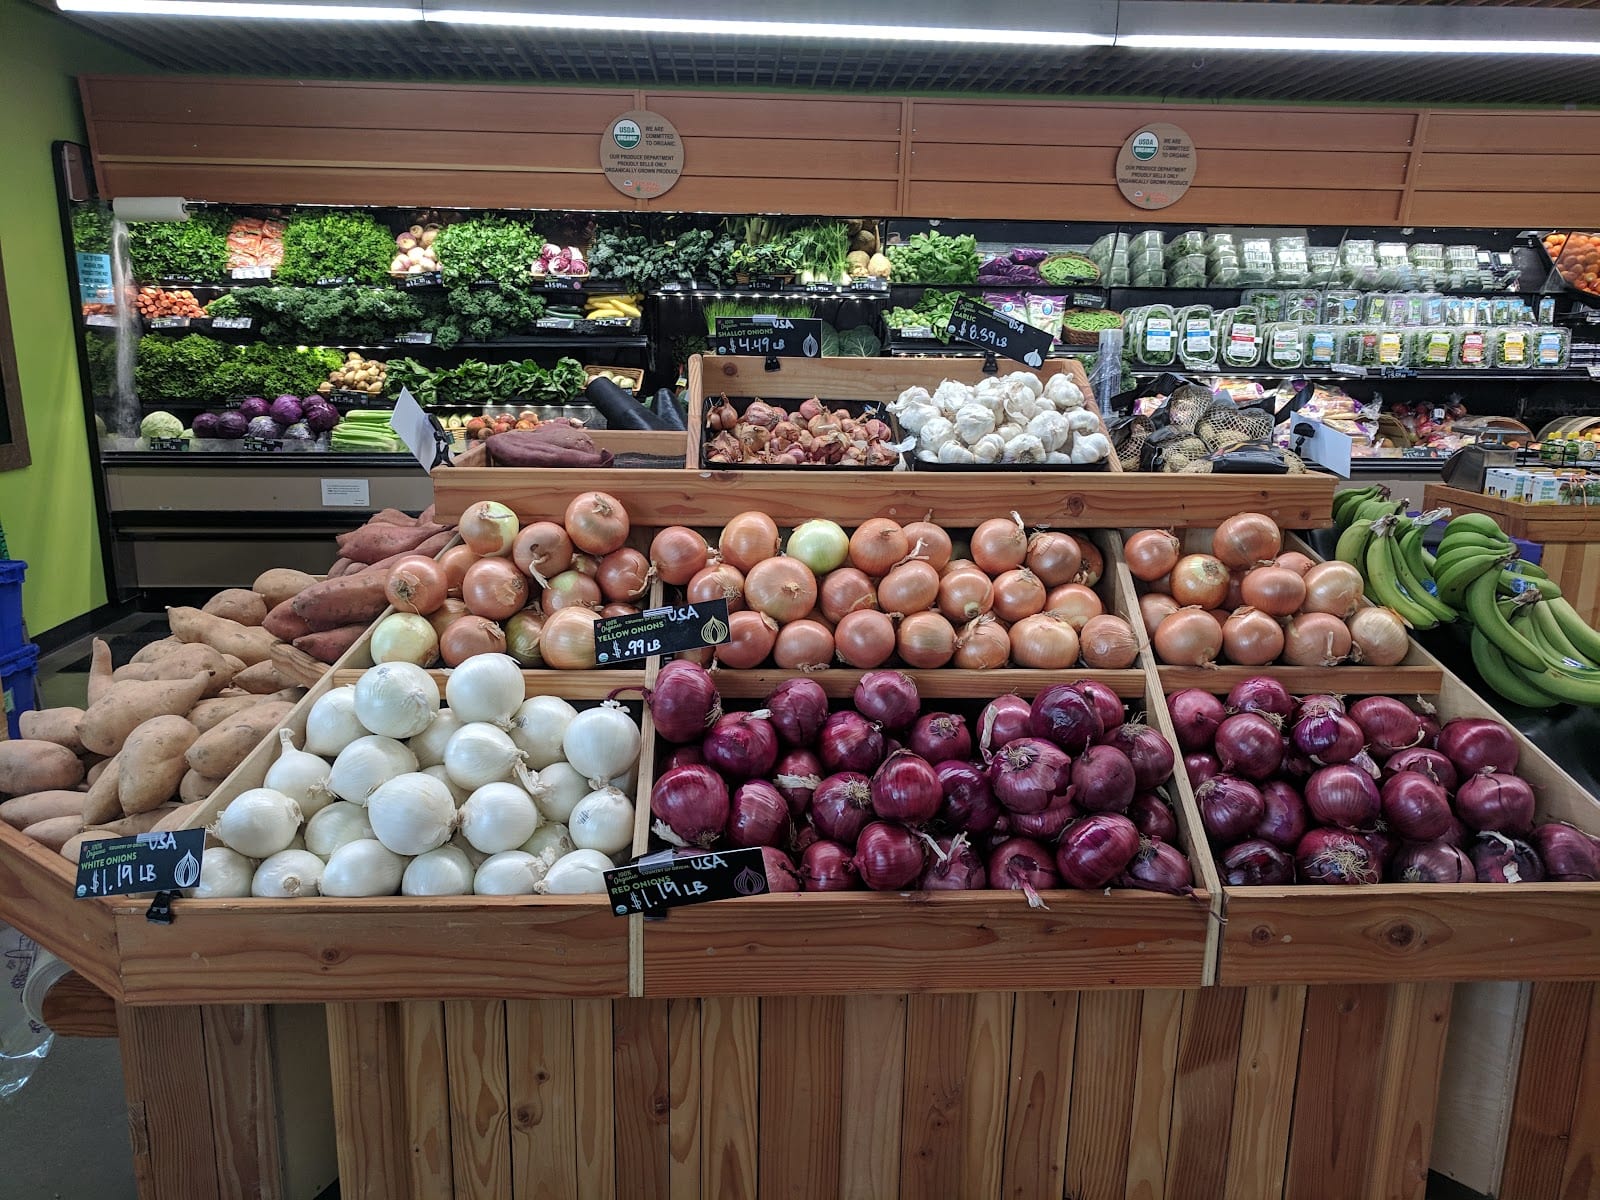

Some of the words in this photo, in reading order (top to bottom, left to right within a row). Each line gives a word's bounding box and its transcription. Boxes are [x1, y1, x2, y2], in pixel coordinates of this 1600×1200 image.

[954, 310, 976, 322] GARLIC
[772, 319, 794, 329] USA
[1009, 320, 1024, 334] USA
[746, 328, 773, 336] ONIONS
[667, 605, 700, 622] USA
[597, 629, 630, 642] YELLOW
[630, 621, 664, 634] ONIONS
[601, 623, 623, 633] Organic
[647, 639, 662, 652] LB
[148, 831, 177, 851] USA
[81, 859, 105, 870] WHITE
[106, 851, 137, 866] ONIONS
[86, 849, 106, 859] Organic
[690, 854, 728, 871] USA
[90, 863, 133, 895] $1.19
[139, 863, 157, 882] LB
[611, 884, 631, 895] RED
[632, 876, 671, 889] ONIONS
[613, 874, 639, 885] Organic
[630, 881, 682, 910] $1.19
[683, 881, 709, 896] LB
